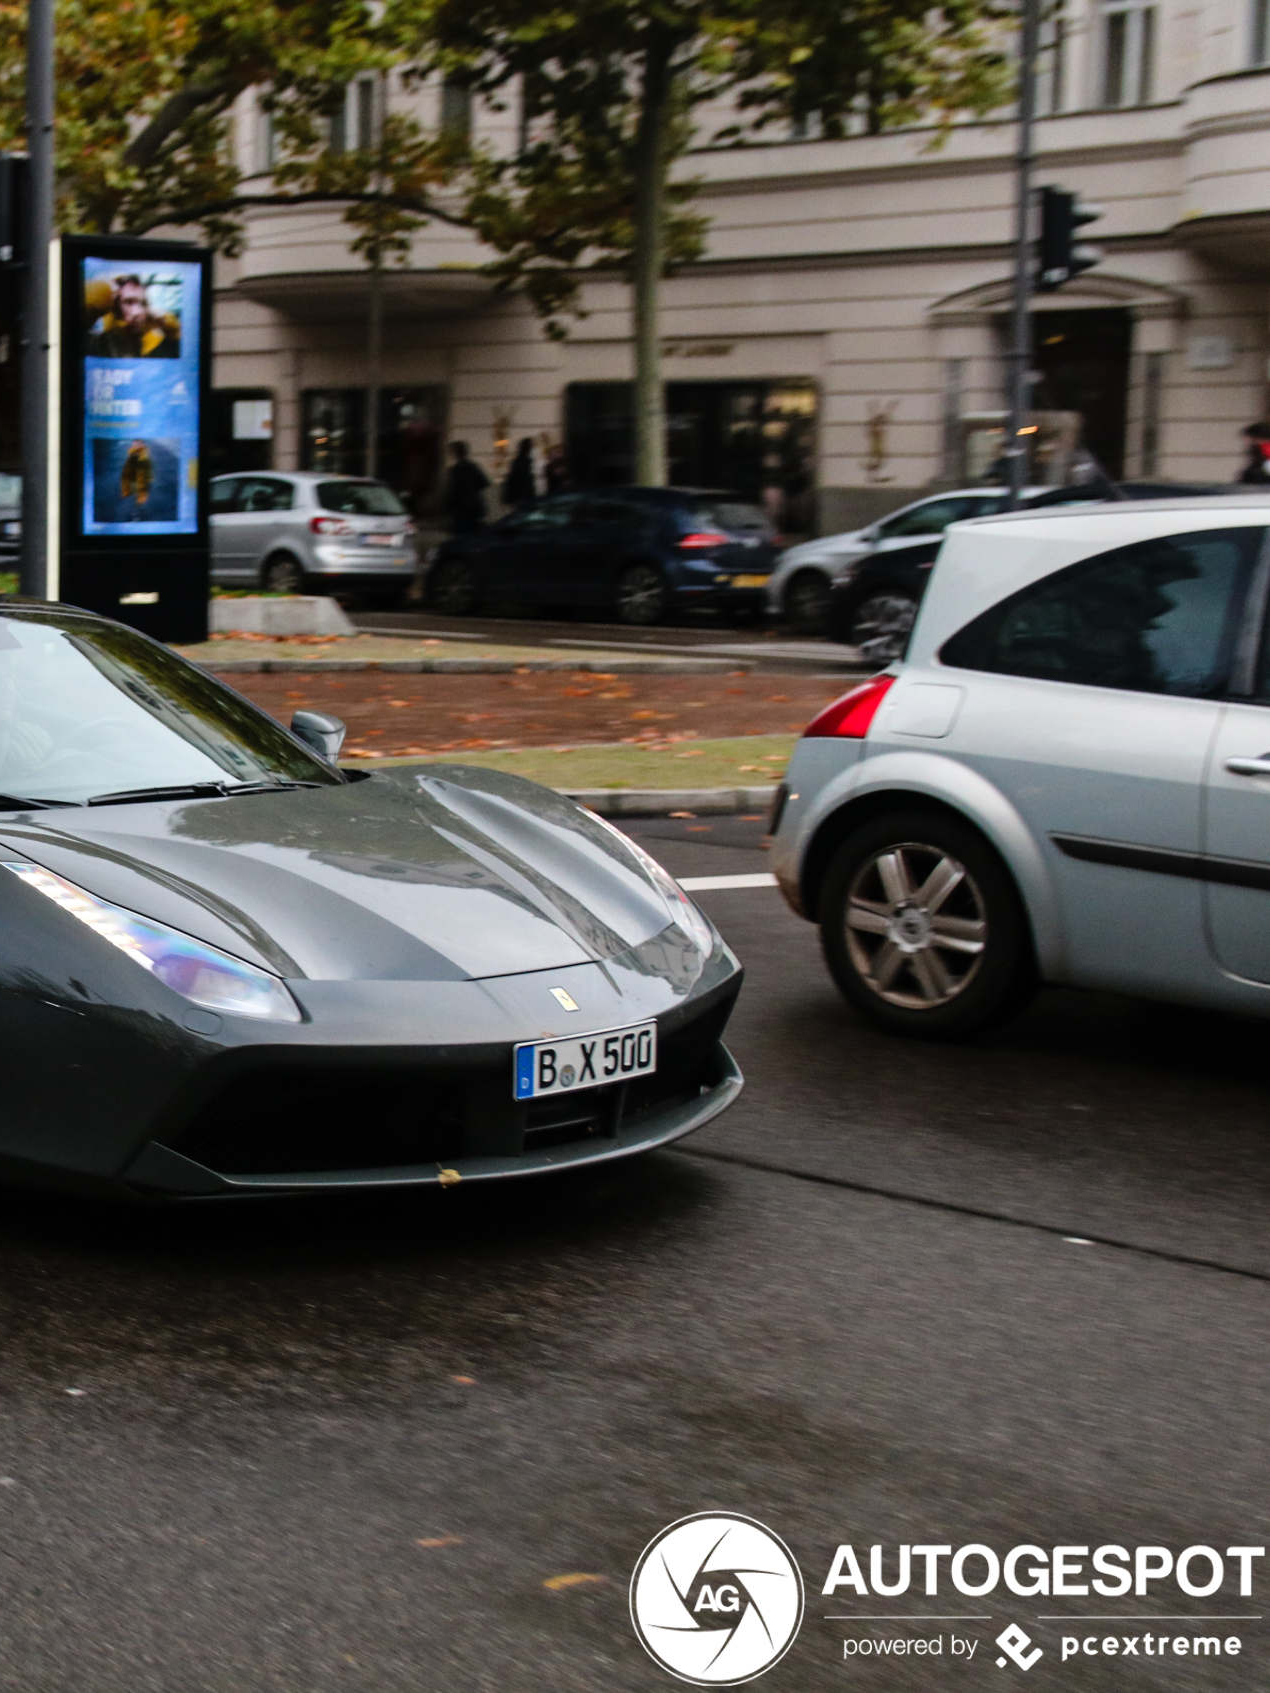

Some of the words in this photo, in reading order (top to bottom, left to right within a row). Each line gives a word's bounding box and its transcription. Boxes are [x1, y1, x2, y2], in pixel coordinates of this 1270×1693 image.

[538, 1048, 557, 1089] B
[579, 1041, 597, 1082] X
[603, 1029, 652, 1076] 500
